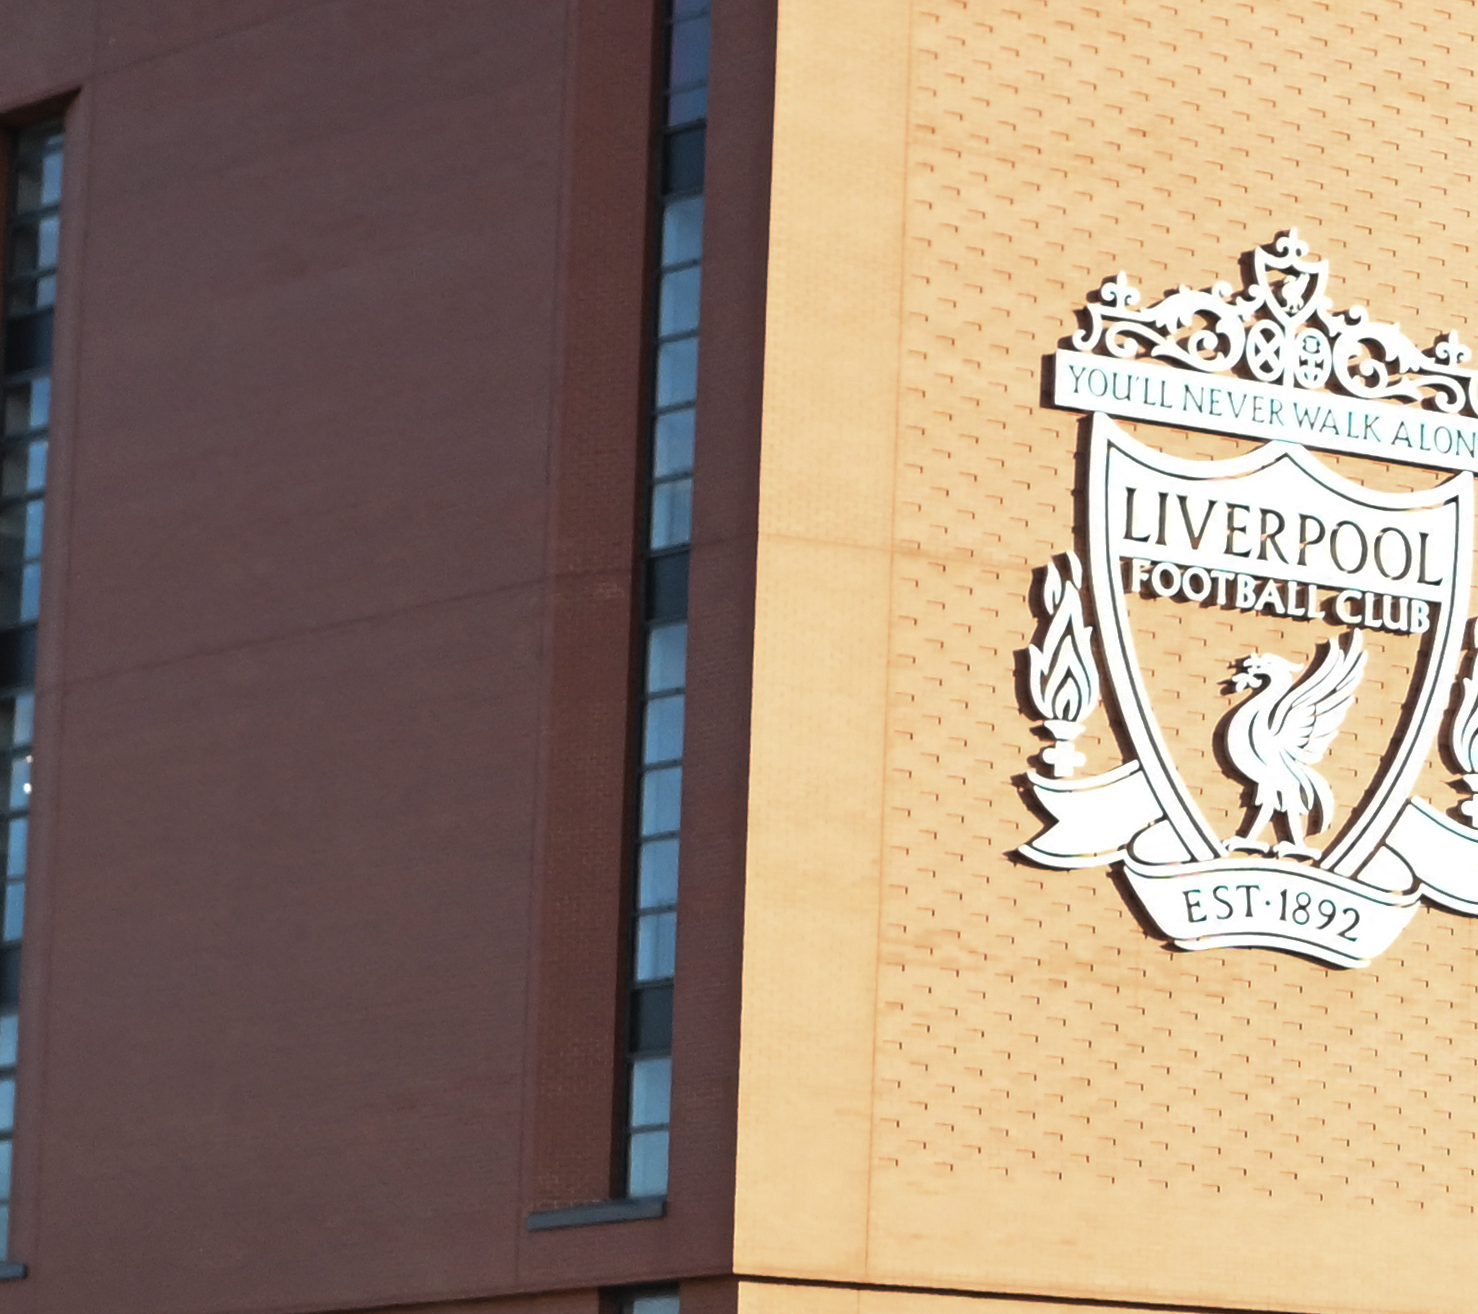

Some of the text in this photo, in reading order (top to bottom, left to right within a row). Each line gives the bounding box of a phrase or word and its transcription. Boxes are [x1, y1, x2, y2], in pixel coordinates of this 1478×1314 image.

[1069, 363, 1173, 411] YOU'LL
[1182, 384, 1286, 426] NEVER
[1293, 401, 1385, 443] WALK
[1122, 485, 1444, 588] LIVERPOOL
[1130, 557, 1431, 635] FOOTBALL CLUB
